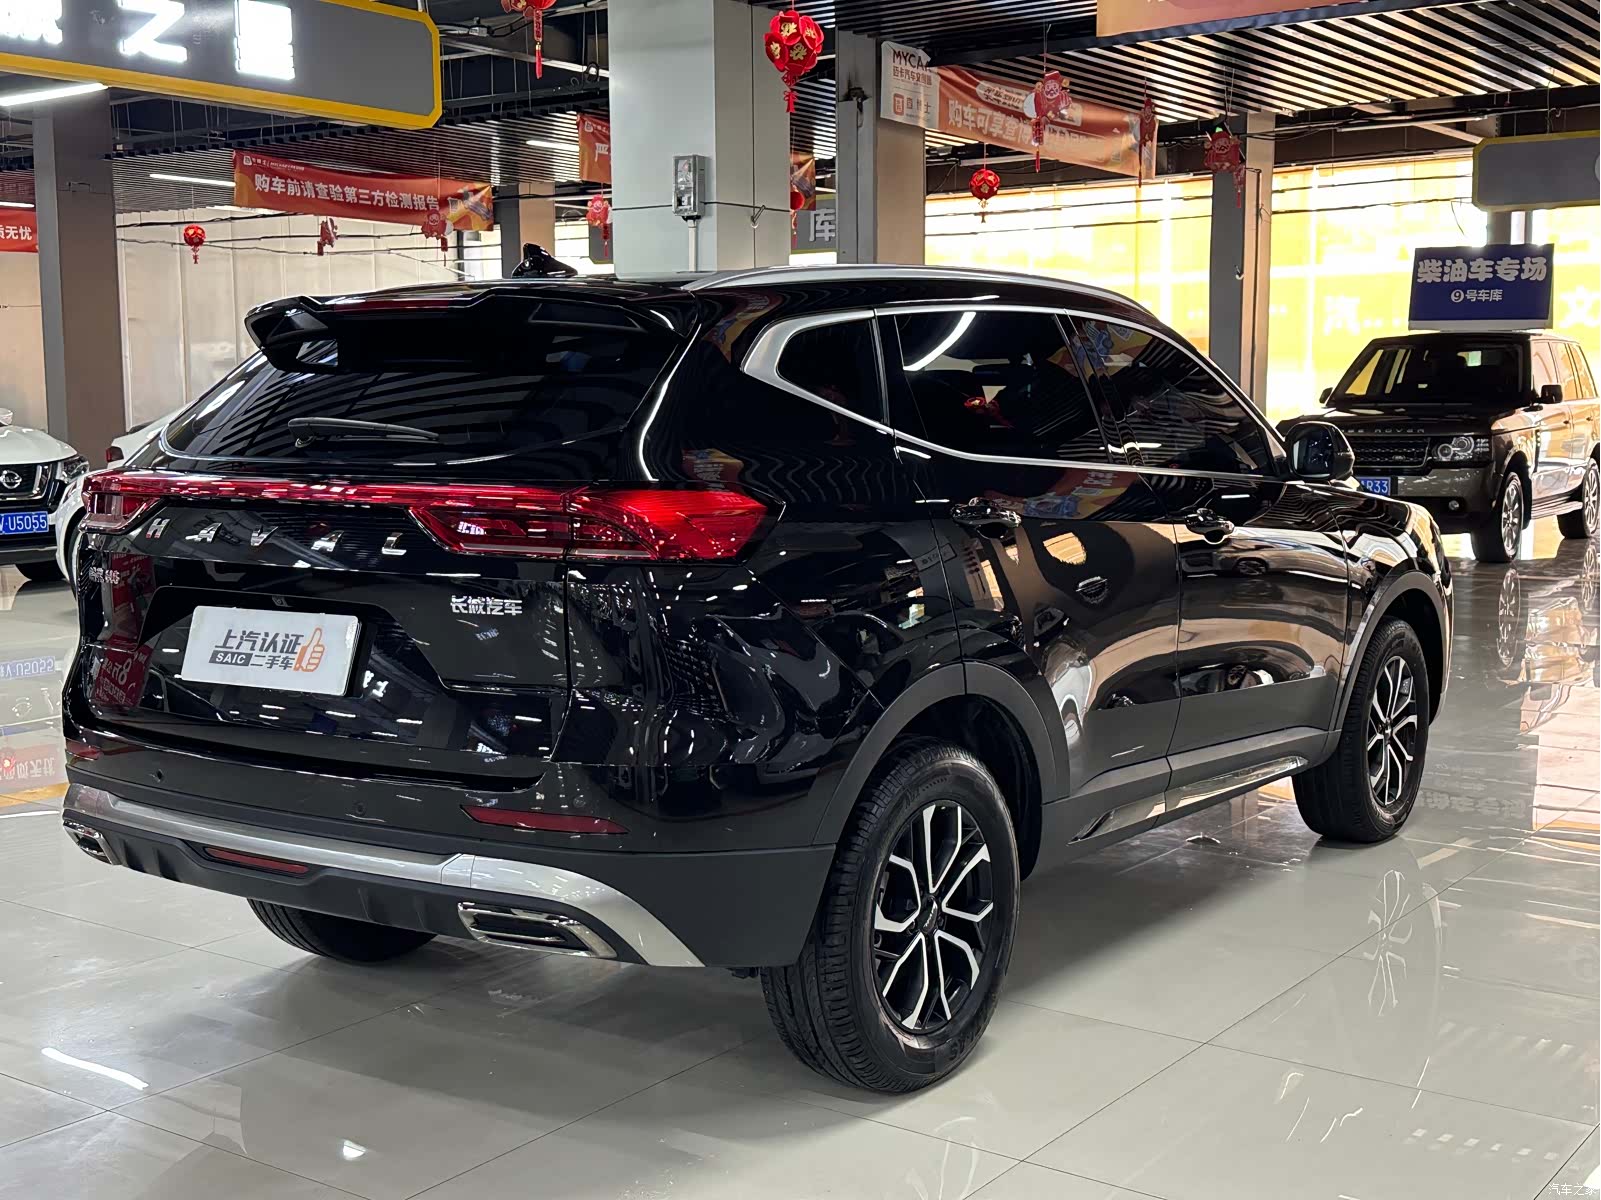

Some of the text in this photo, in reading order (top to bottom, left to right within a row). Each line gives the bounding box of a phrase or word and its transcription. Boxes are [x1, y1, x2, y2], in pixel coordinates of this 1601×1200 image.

[254, 173, 440, 211] 购车前请查验第三方检测报告
[1417, 256, 1548, 283] 柴油车专场
[146, 518, 407, 555] HAVAL
[450, 594, 523, 616] 长城汽车
[214, 629, 304, 655] 上汽认证
[215, 652, 247, 664] SAIC
[250, 654, 296, 670] 二手车
